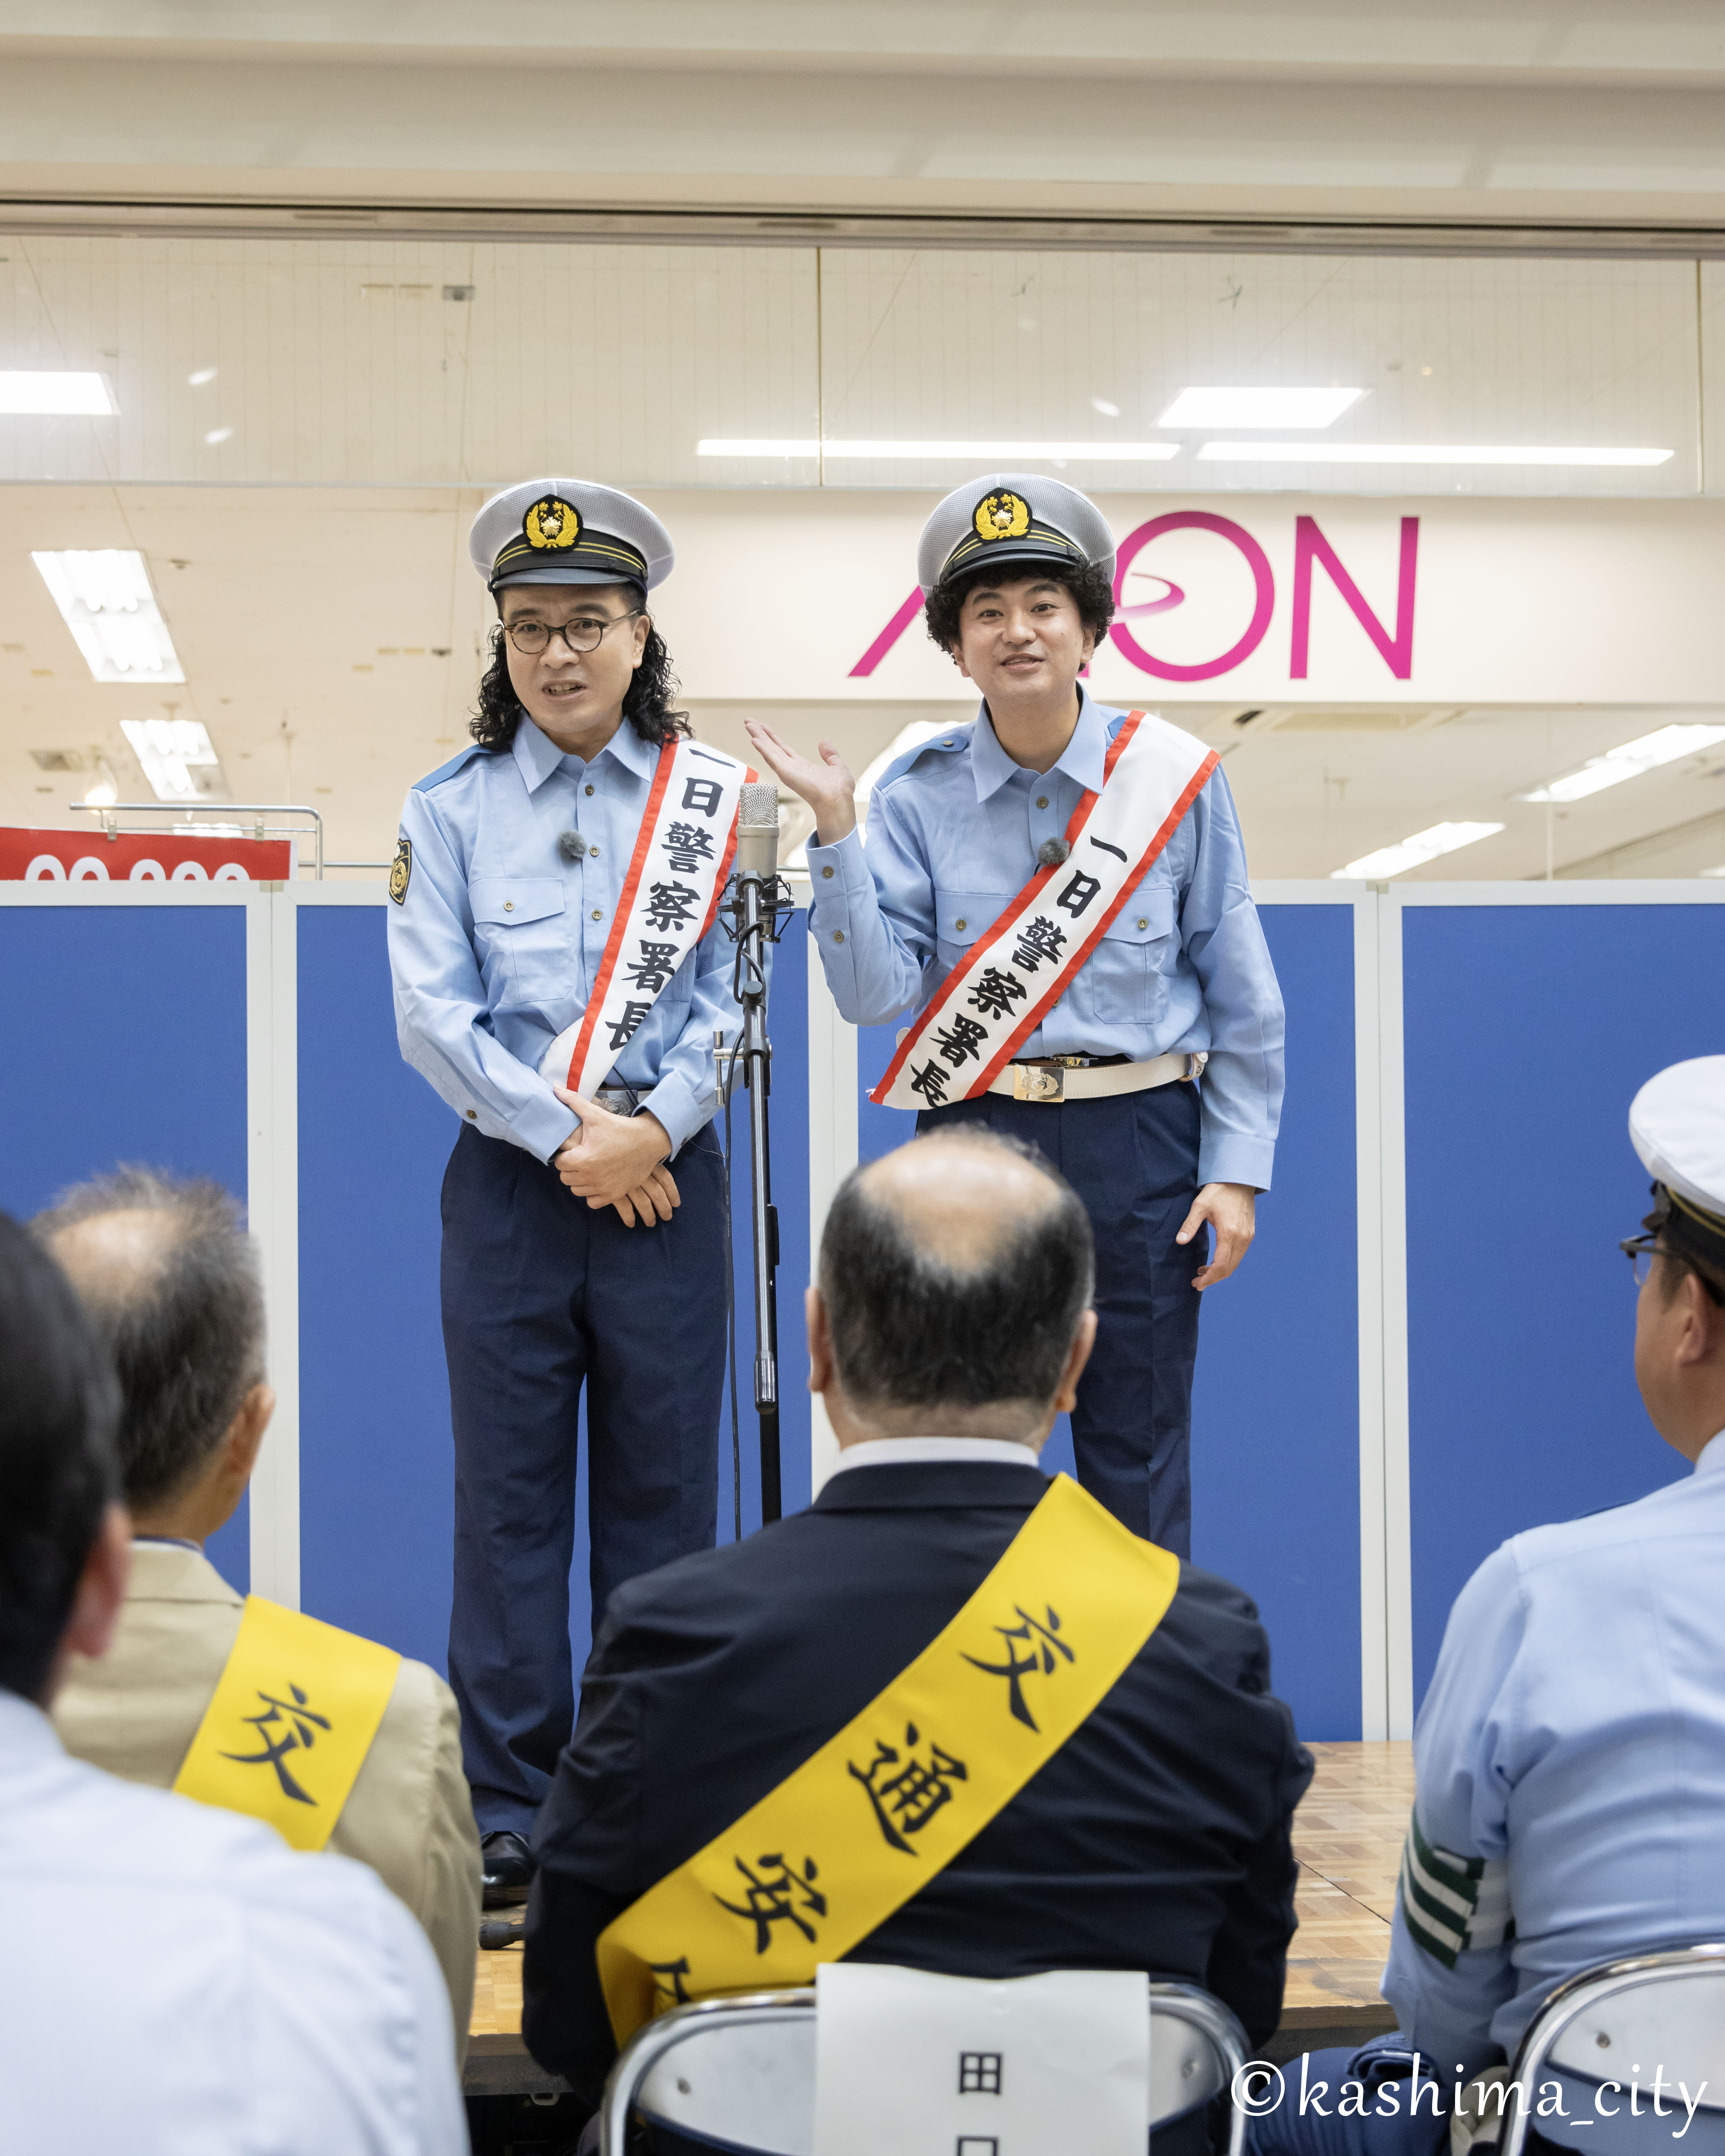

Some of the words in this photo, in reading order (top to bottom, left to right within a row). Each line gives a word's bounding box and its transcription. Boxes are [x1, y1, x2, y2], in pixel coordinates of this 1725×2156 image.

[605, 748, 736, 1051] 一日警察署長
[910, 836, 1128, 1108] 一日警察署長
[216, 1681, 332, 1807] 交
